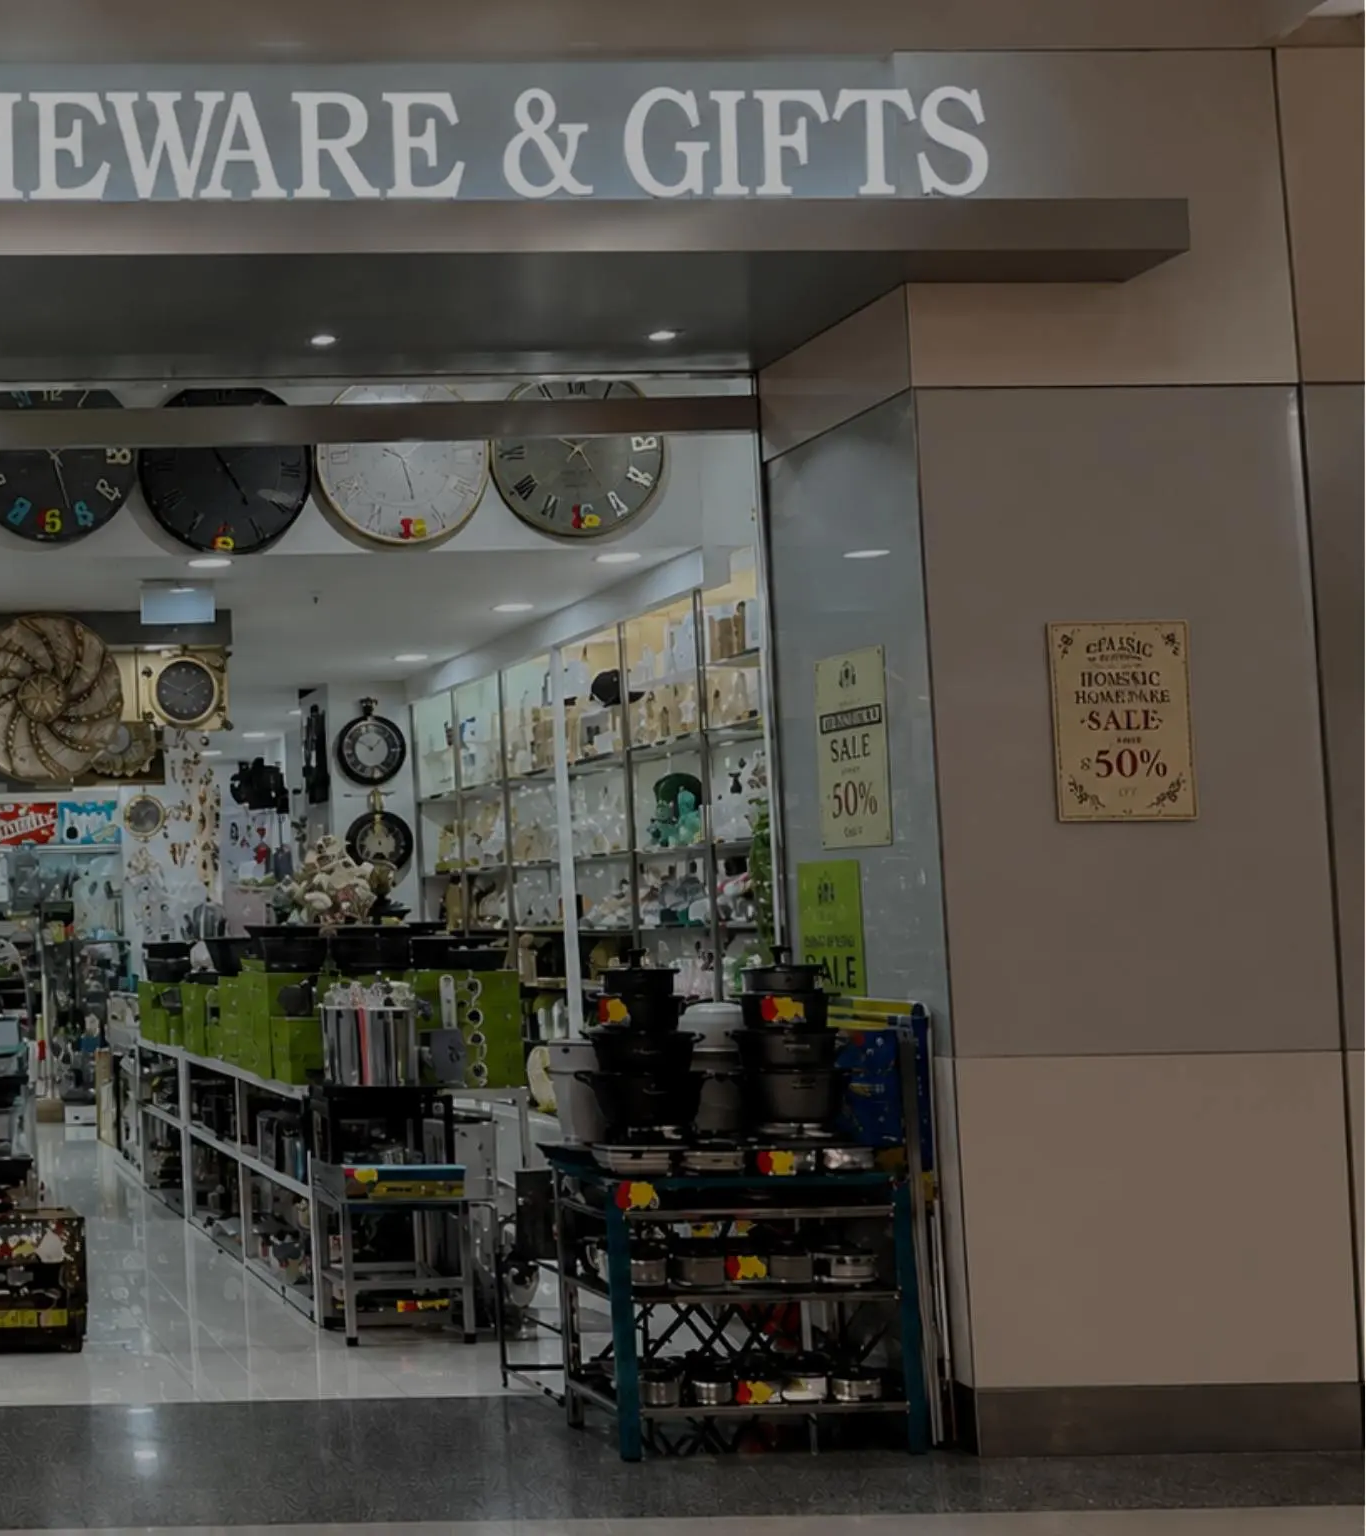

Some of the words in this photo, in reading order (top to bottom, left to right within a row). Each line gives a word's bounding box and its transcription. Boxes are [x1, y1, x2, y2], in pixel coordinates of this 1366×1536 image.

[502, 86, 594, 198] &
[623, 85, 990, 198] GIFTS
[830, 733, 872, 763] SALE
[1095, 748, 1168, 778] 50%
[831, 780, 878, 819] 50%
